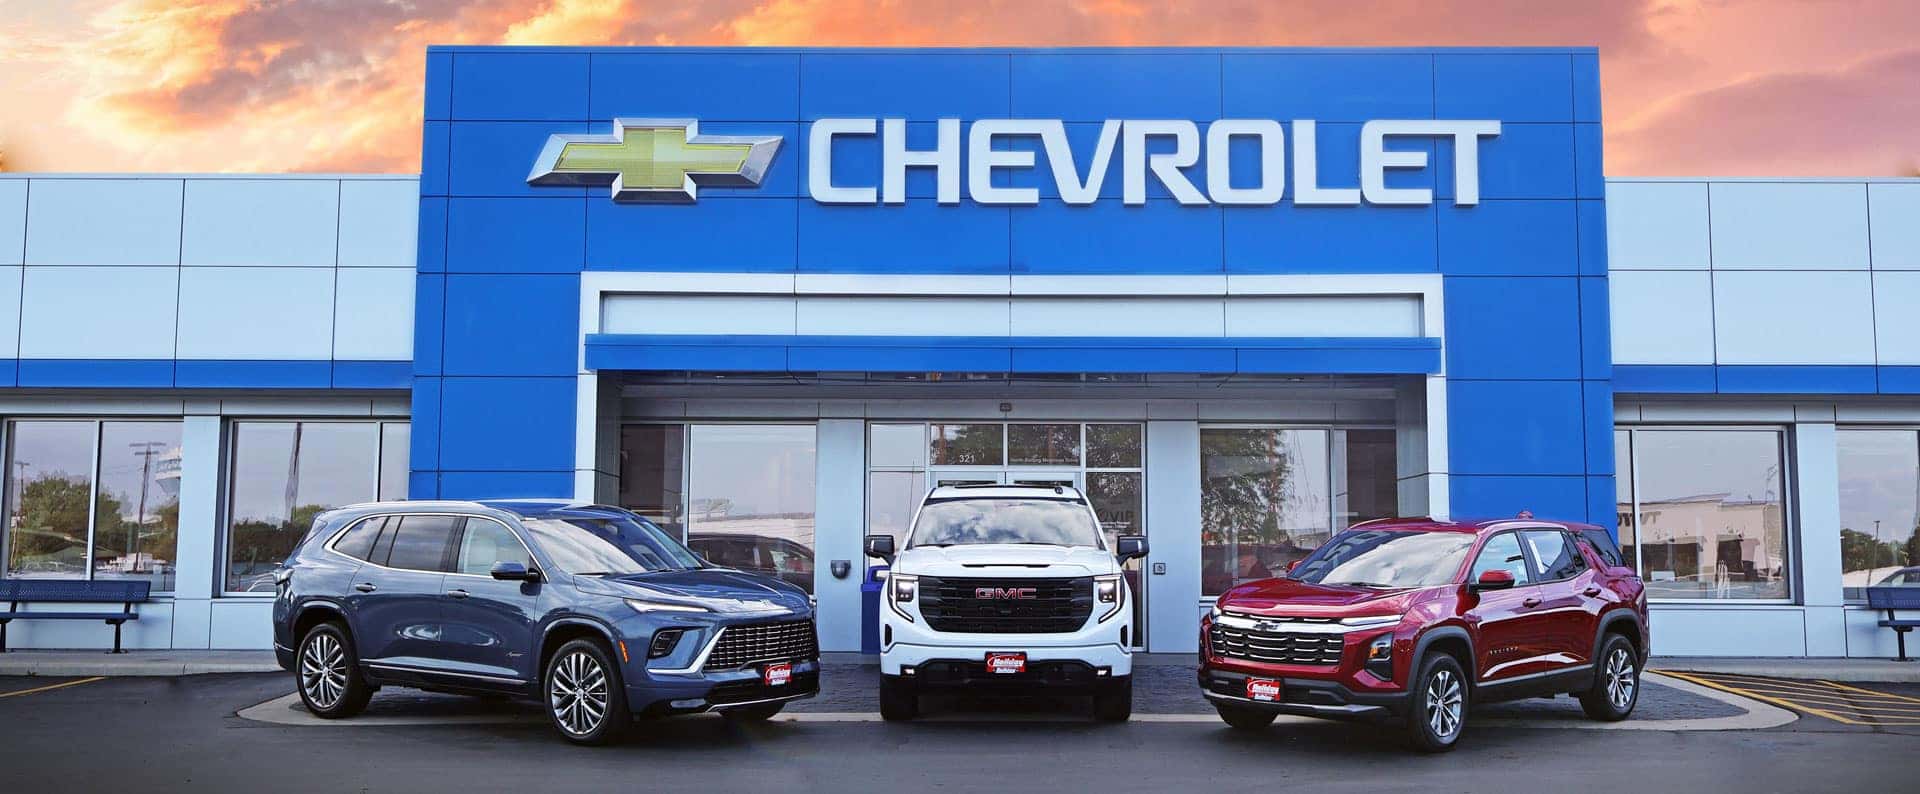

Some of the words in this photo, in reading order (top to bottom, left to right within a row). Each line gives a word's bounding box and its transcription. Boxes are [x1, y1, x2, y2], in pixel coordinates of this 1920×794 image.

[809, 118, 1501, 205] CHEVROLET
[959, 454, 975, 463] 321
[975, 587, 1037, 600] GMC
[993, 657, 1025, 667] Holiday
